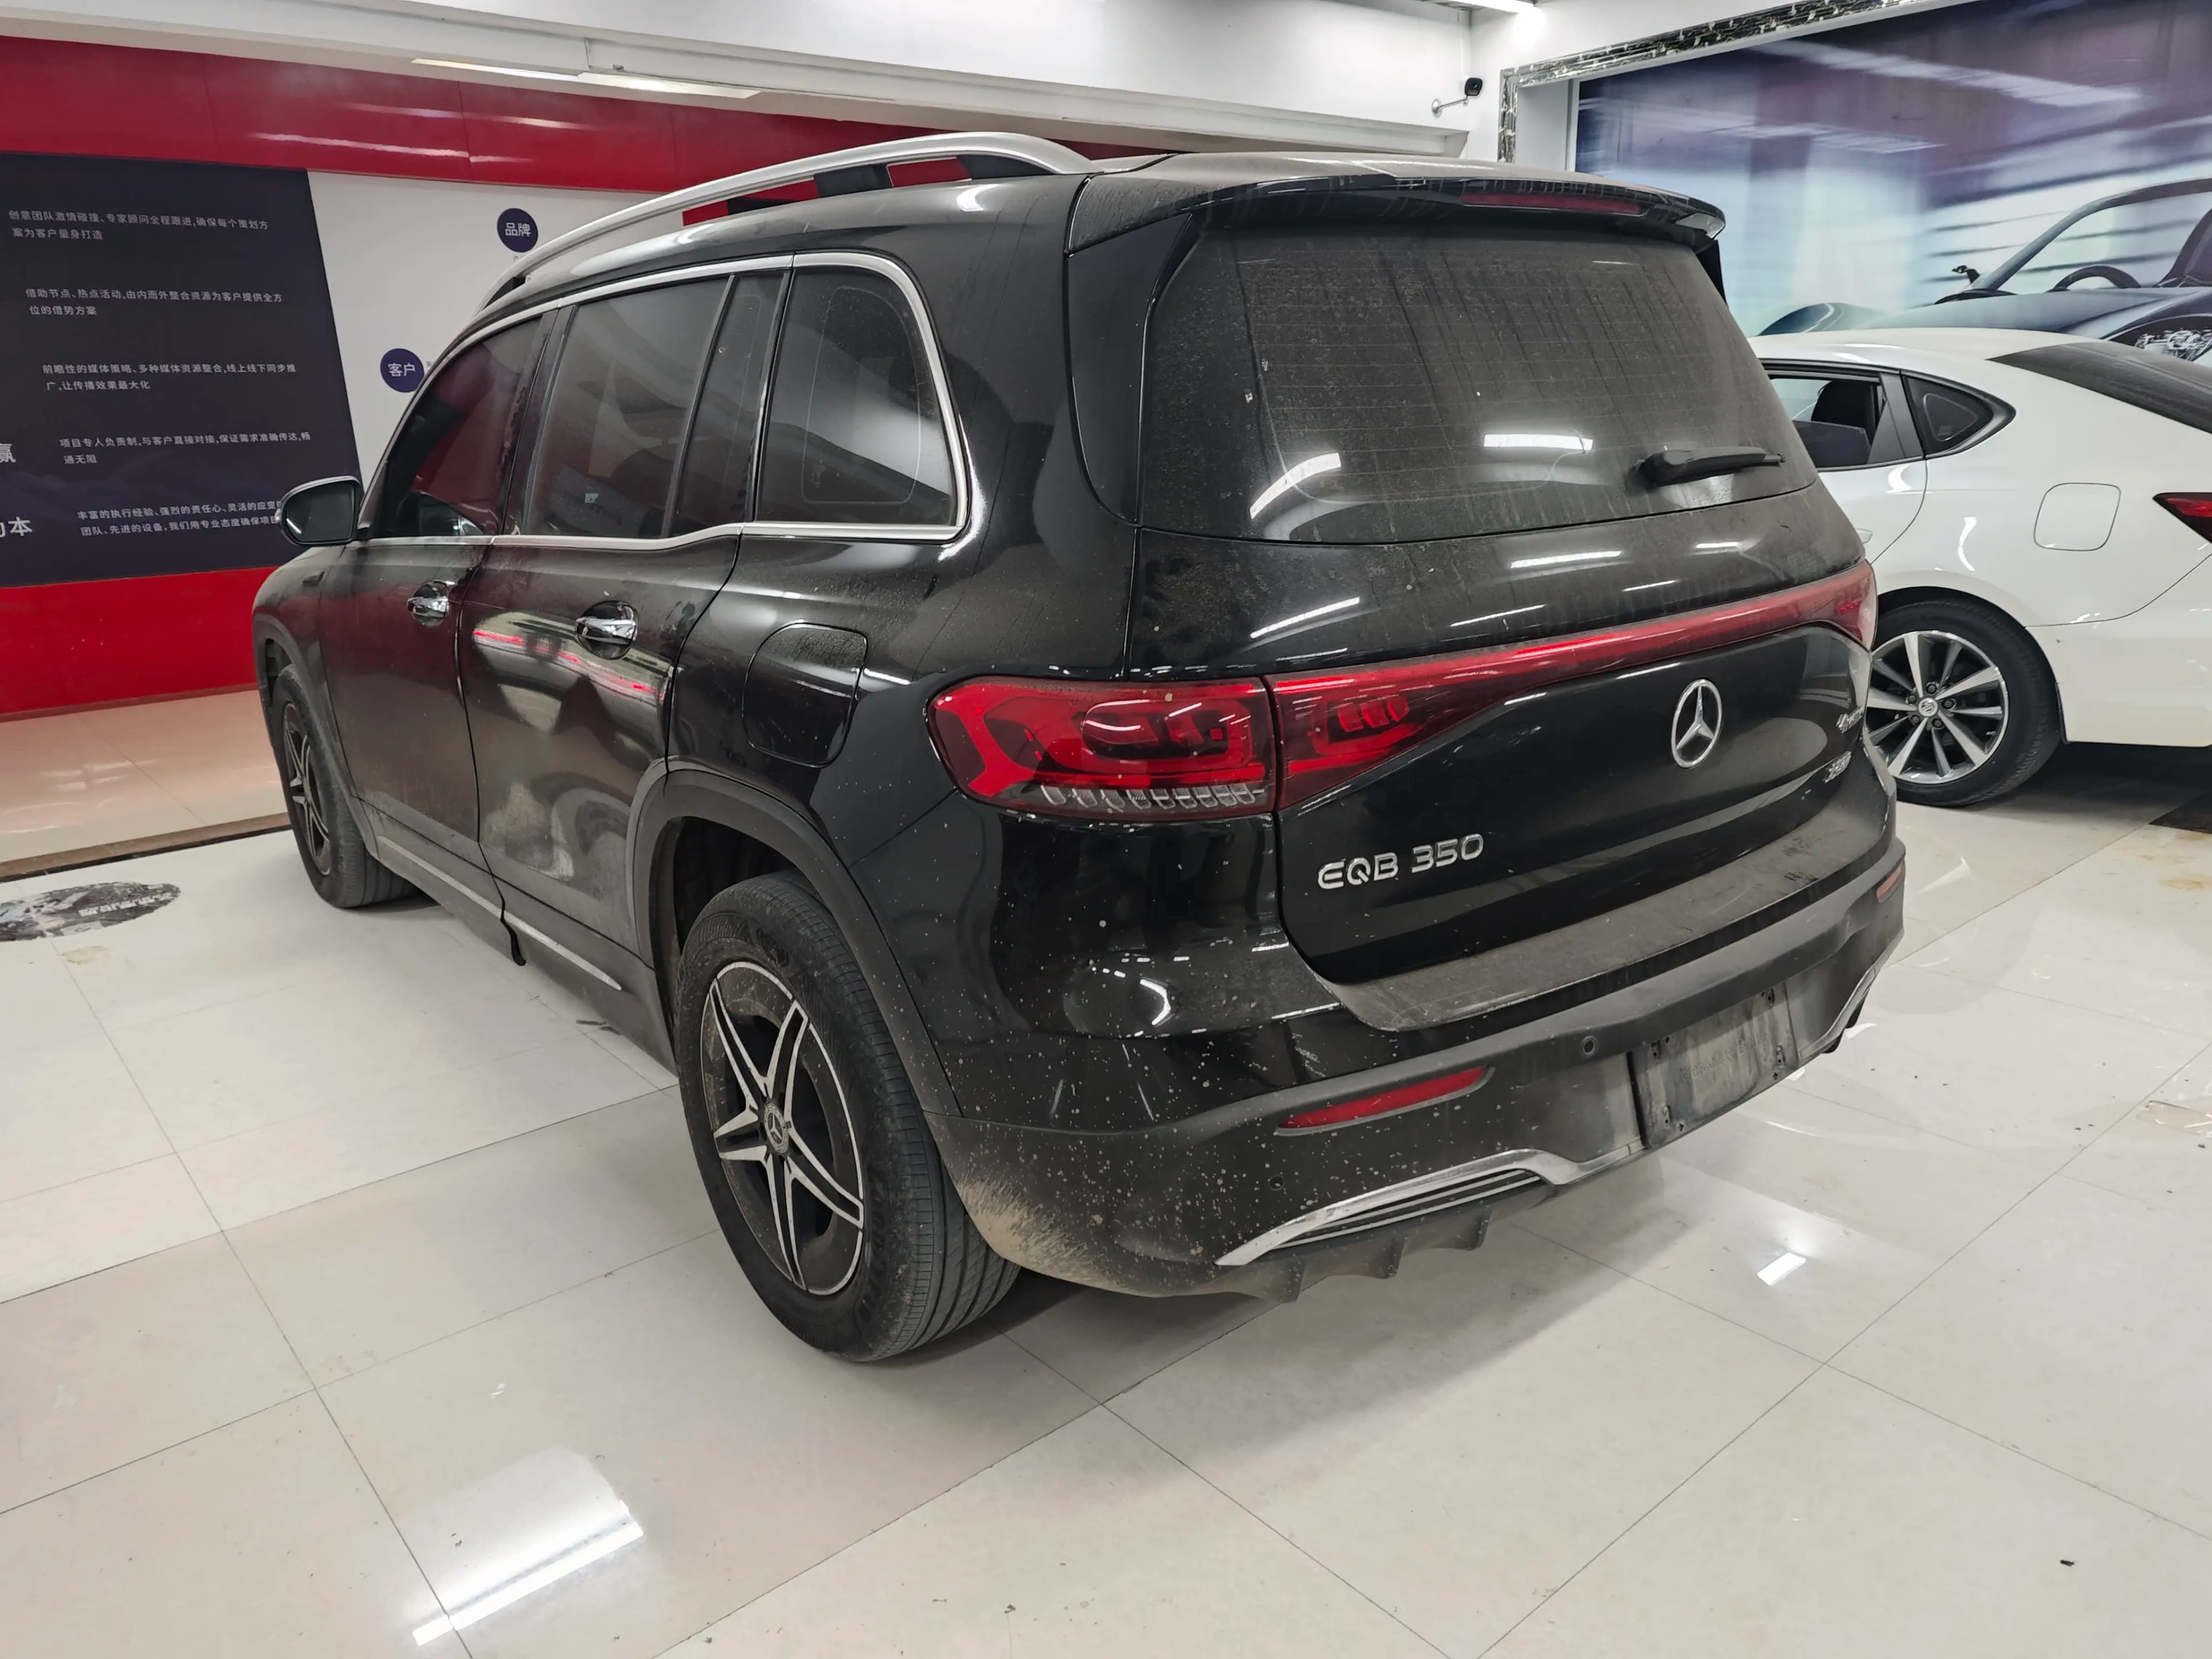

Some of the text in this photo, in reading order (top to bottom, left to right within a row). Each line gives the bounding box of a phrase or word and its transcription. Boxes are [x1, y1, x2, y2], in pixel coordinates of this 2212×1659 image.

[12, 228, 104, 240] 案为客户量身打造
[505, 222, 531, 237] 品牌
[29, 305, 97, 316] 位的借势方案
[388, 362, 415, 377] 客户
[63, 454, 97, 464] 通无阻
[0, 516, 33, 537] 本
[1317, 834, 1484, 889] EQB 350
